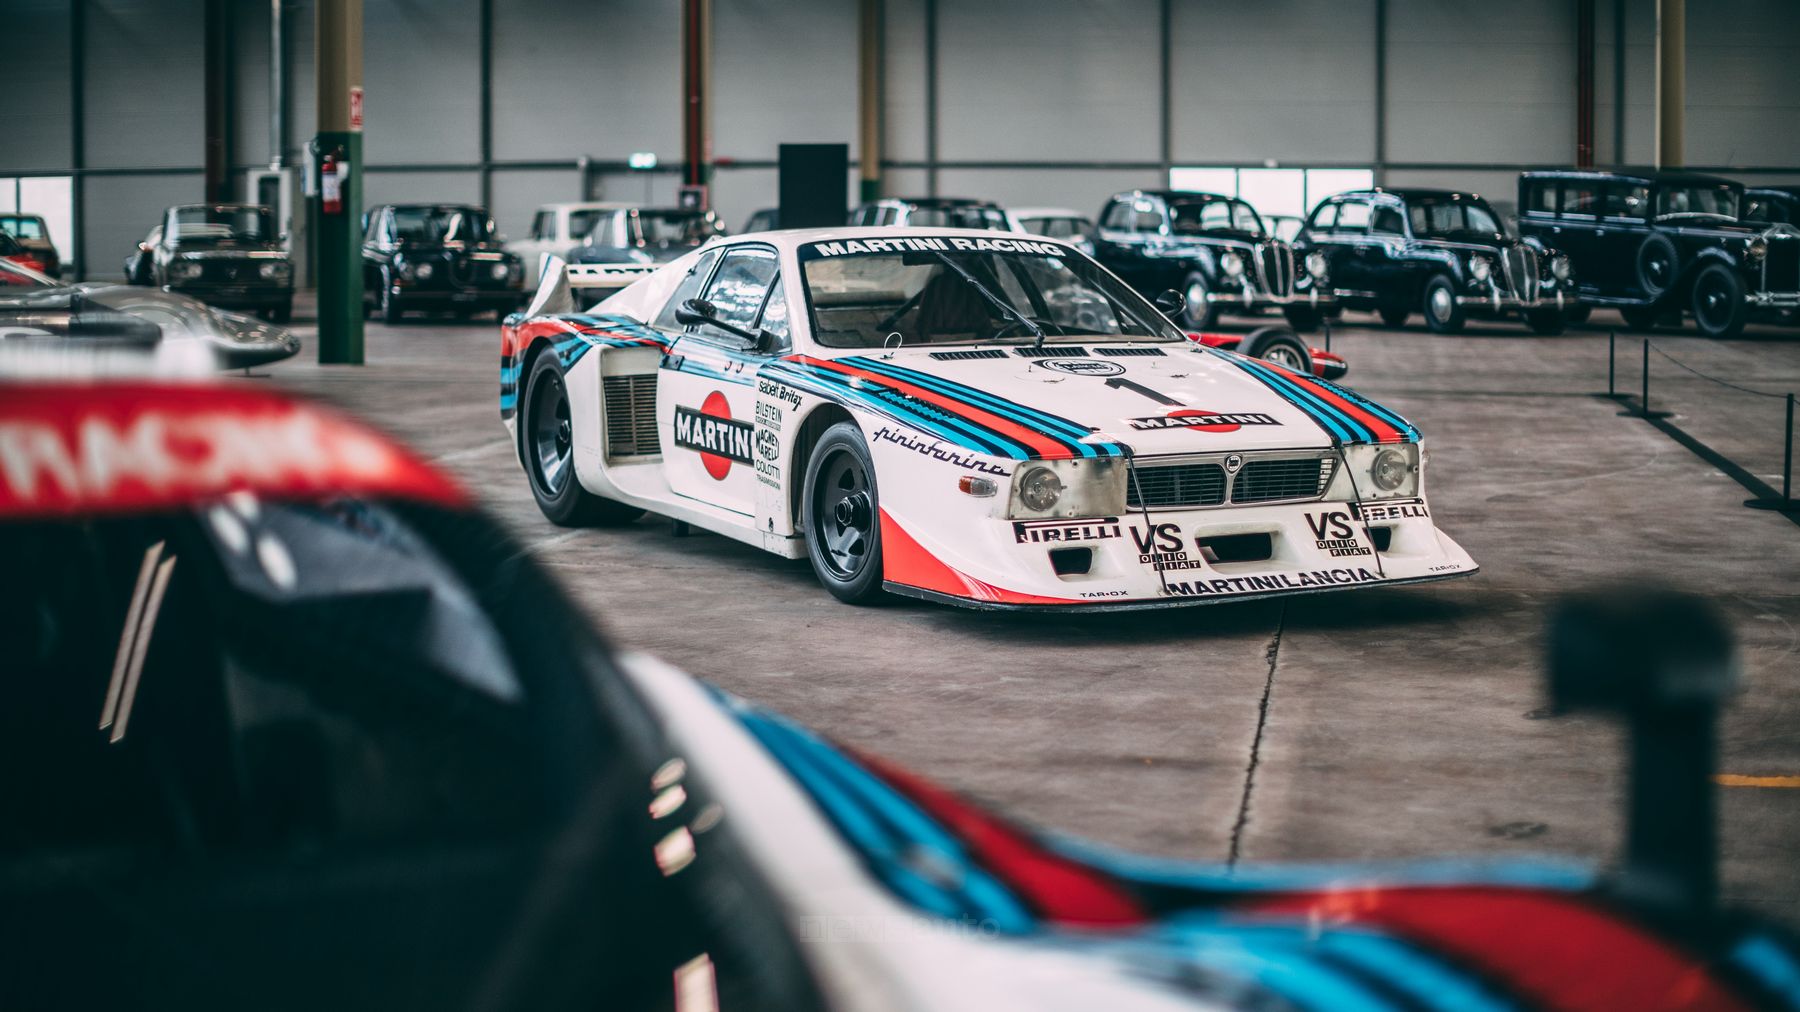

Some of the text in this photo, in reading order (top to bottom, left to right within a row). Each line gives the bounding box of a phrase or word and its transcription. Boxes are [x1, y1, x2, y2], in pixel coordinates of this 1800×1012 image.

[814, 237, 1066, 257] MARTINI RACING
[779, 386, 803, 411] Britax
[1104, 377, 1187, 406] 1
[755, 400, 782, 423] BILSTEIN
[1132, 413, 1273, 430] MARTINI
[676, 412, 755, 460] MARTINI
[873, 426, 1012, 477] pininfarina
[755, 458, 781, 481] COLOTTI
[1012, 517, 1123, 544] PIRELLI
[1304, 511, 1354, 540] VS
[1129, 523, 1184, 554] VS
[1316, 540, 1358, 549] OLIO
[1139, 552, 1188, 564] OIO
[1330, 548, 1371, 557] FIAT
[1166, 567, 1379, 596] MARTINI LANCIA
